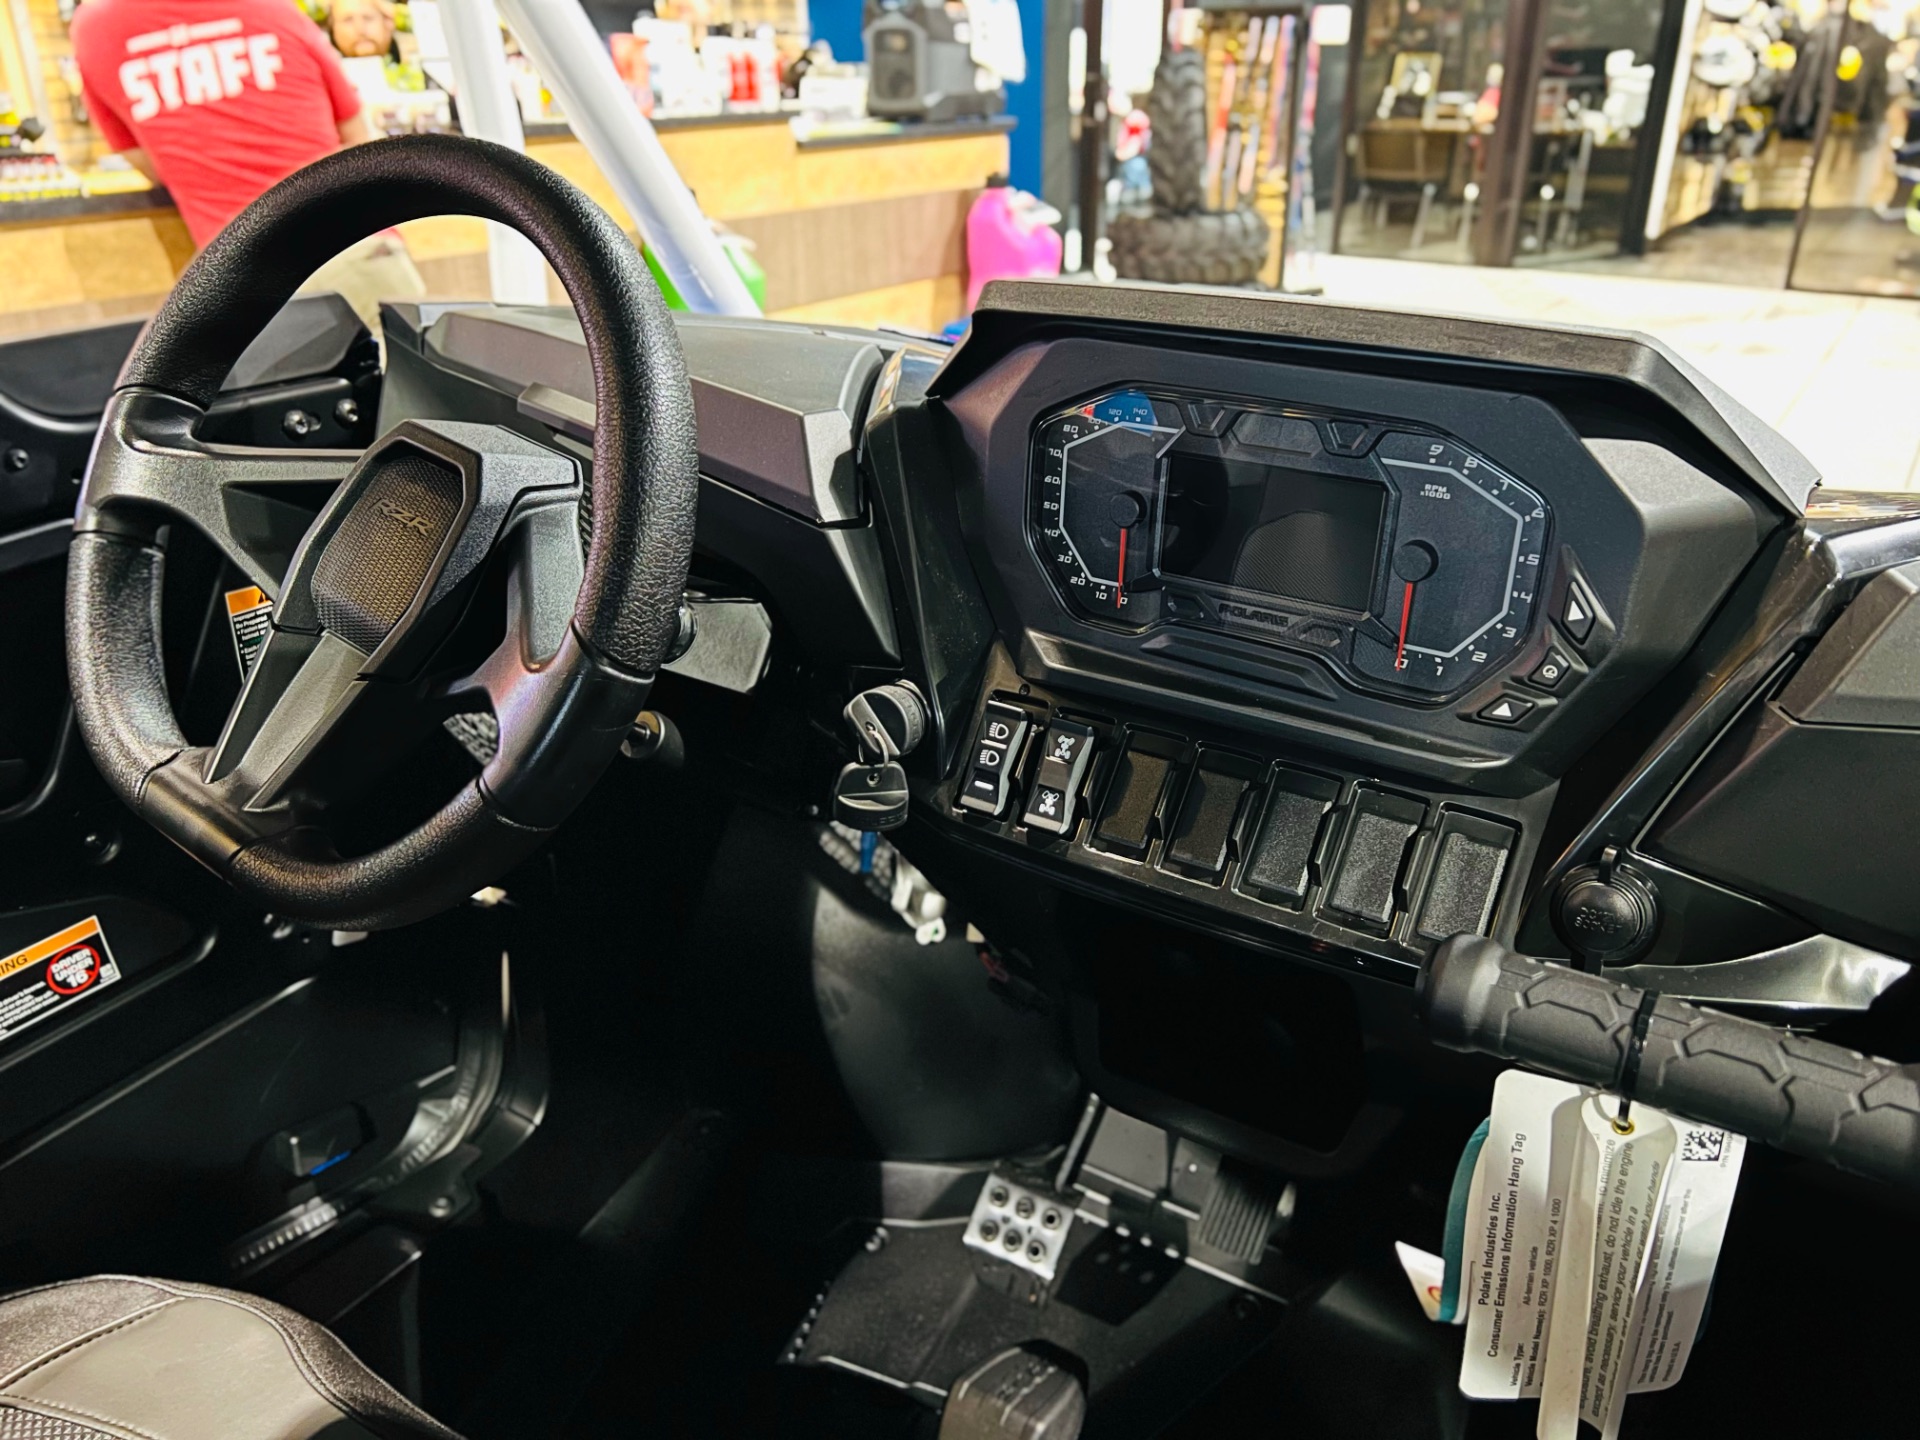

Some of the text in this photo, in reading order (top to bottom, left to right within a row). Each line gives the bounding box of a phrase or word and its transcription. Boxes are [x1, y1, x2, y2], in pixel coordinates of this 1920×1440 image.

[118, 32, 283, 123] STAFF
[1108, 408, 1122, 416] 120
[1132, 407, 1148, 416] 140
[1062, 424, 1079, 433] 80
[1428, 444, 1444, 455] 9
[1465, 457, 1479, 469] 8
[1044, 476, 1059, 485] 60
[1424, 483, 1448, 493] RPM
[1500, 479, 1509, 490] 7
[1043, 502, 1059, 511] 50
[1531, 507, 1545, 519] 6
[1044, 529, 1060, 538] 40
[1057, 554, 1072, 564] 30
[1526, 554, 1540, 565] 5
[1070, 576, 1086, 586] 20
[1095, 591, 1107, 600] 10
[1119, 596, 1128, 605] 0
[1520, 592, 1533, 604] 4
[1218, 602, 1289, 627] POLARIS
[1502, 627, 1517, 638] 3
[1395, 658, 1409, 669] 0
[1471, 651, 1487, 663] 2
[1436, 665, 1444, 676] 1
[0, 953, 28, 976] ING
[50, 947, 92, 974] DRIVER
[54, 956, 94, 982] UNDER
[66, 969, 89, 988] 16
[1599, 1139, 1616, 1184] minimize
[1619, 1142, 1634, 1176] engine
[1648, 1161, 1660, 1194] hands
[1615, 1179, 1626, 1194] the
[1551, 1198, 1561, 1216] 1000
[1610, 1196, 1623, 1214] idle
[1629, 1206, 1638, 1214] a
[1643, 1194, 1655, 1218] your
[1608, 1216, 1620, 1233] not
[1625, 1216, 1636, 1226] in
[1547, 1226, 1557, 1237] XP
[1636, 1220, 1648, 1246] wash
[1478, 1192, 1500, 1305] Polaris Industries Inc.
[1487, 1133, 1526, 1357] Consumer Emissions Information Hang Tag
[1545, 1240, 1556, 1256] RZR
[1604, 1234, 1616, 1248] do
[1619, 1227, 1634, 1261] vehicle
[1542, 1258, 1554, 1276] 1000,
[1597, 1252, 1614, 1290] exhaust,
[1616, 1262, 1626, 1288] your
[1540, 1278, 1549, 1289] XP
[1538, 1291, 1548, 1306] RZR
[1609, 1287, 1623, 1322] service
[1510, 1246, 1538, 1386] Vehicle Type: All-terrain vehicle
[1587, 1292, 1608, 1336] breathing
[1532, 1309, 1546, 1339] Name(s):
[1528, 1342, 1540, 1361] Model
[1585, 1337, 1597, 1364] avoid
[1524, 1364, 1536, 1387] Vehicle
[1597, 1374, 1606, 1386] as
[1591, 1385, 1604, 1417] except
